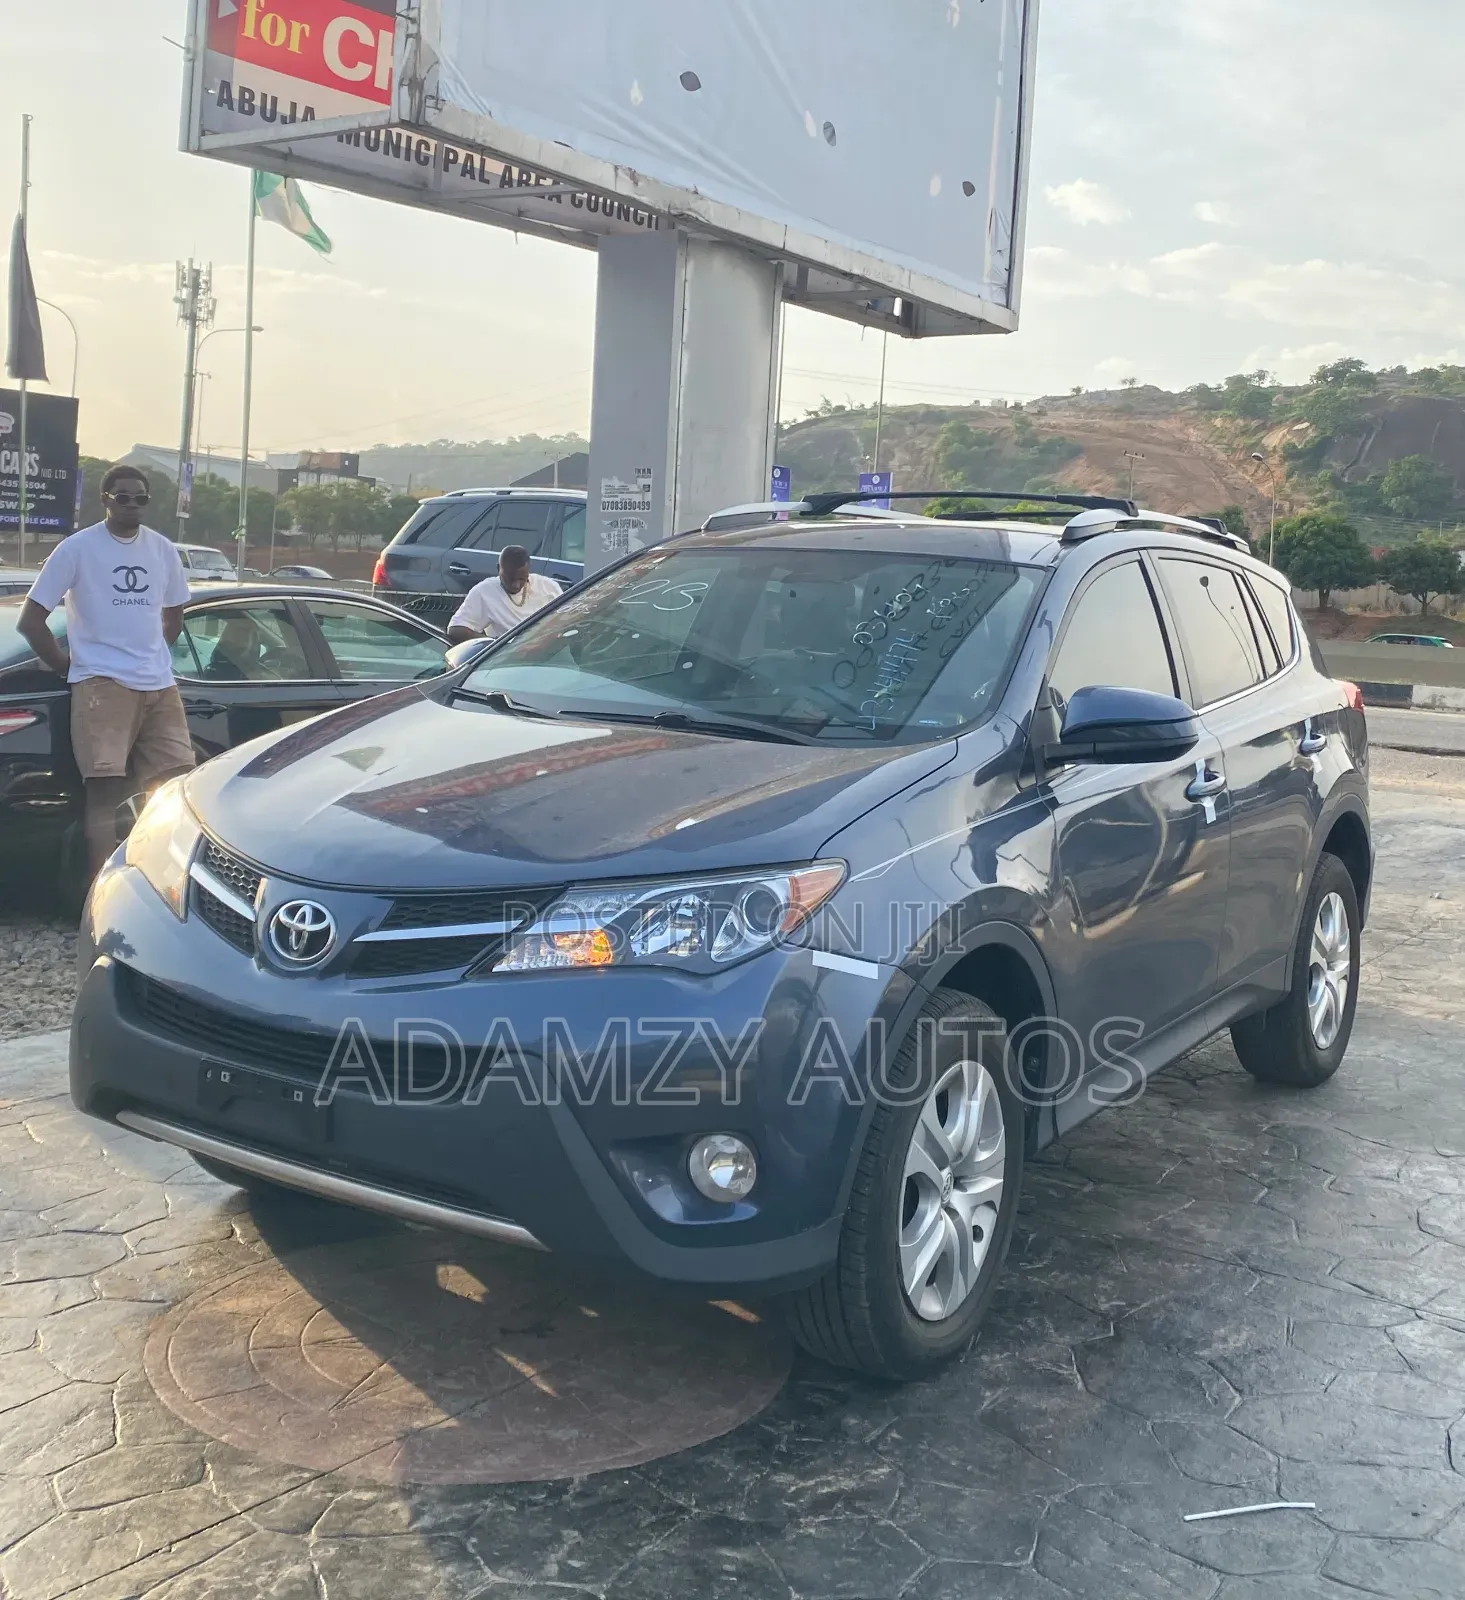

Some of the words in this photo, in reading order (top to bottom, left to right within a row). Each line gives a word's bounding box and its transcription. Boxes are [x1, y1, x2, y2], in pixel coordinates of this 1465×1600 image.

[241, 0, 310, 54] for
[216, 79, 316, 125] ABUJA
[1, 450, 40, 477] CARS
[55, 469, 67, 480] LTD
[0, 501, 35, 511] SWP
[39, 518, 60, 526] CARS
[112, 598, 151, 606] CHANEL
[618, 579, 709, 611] 23
